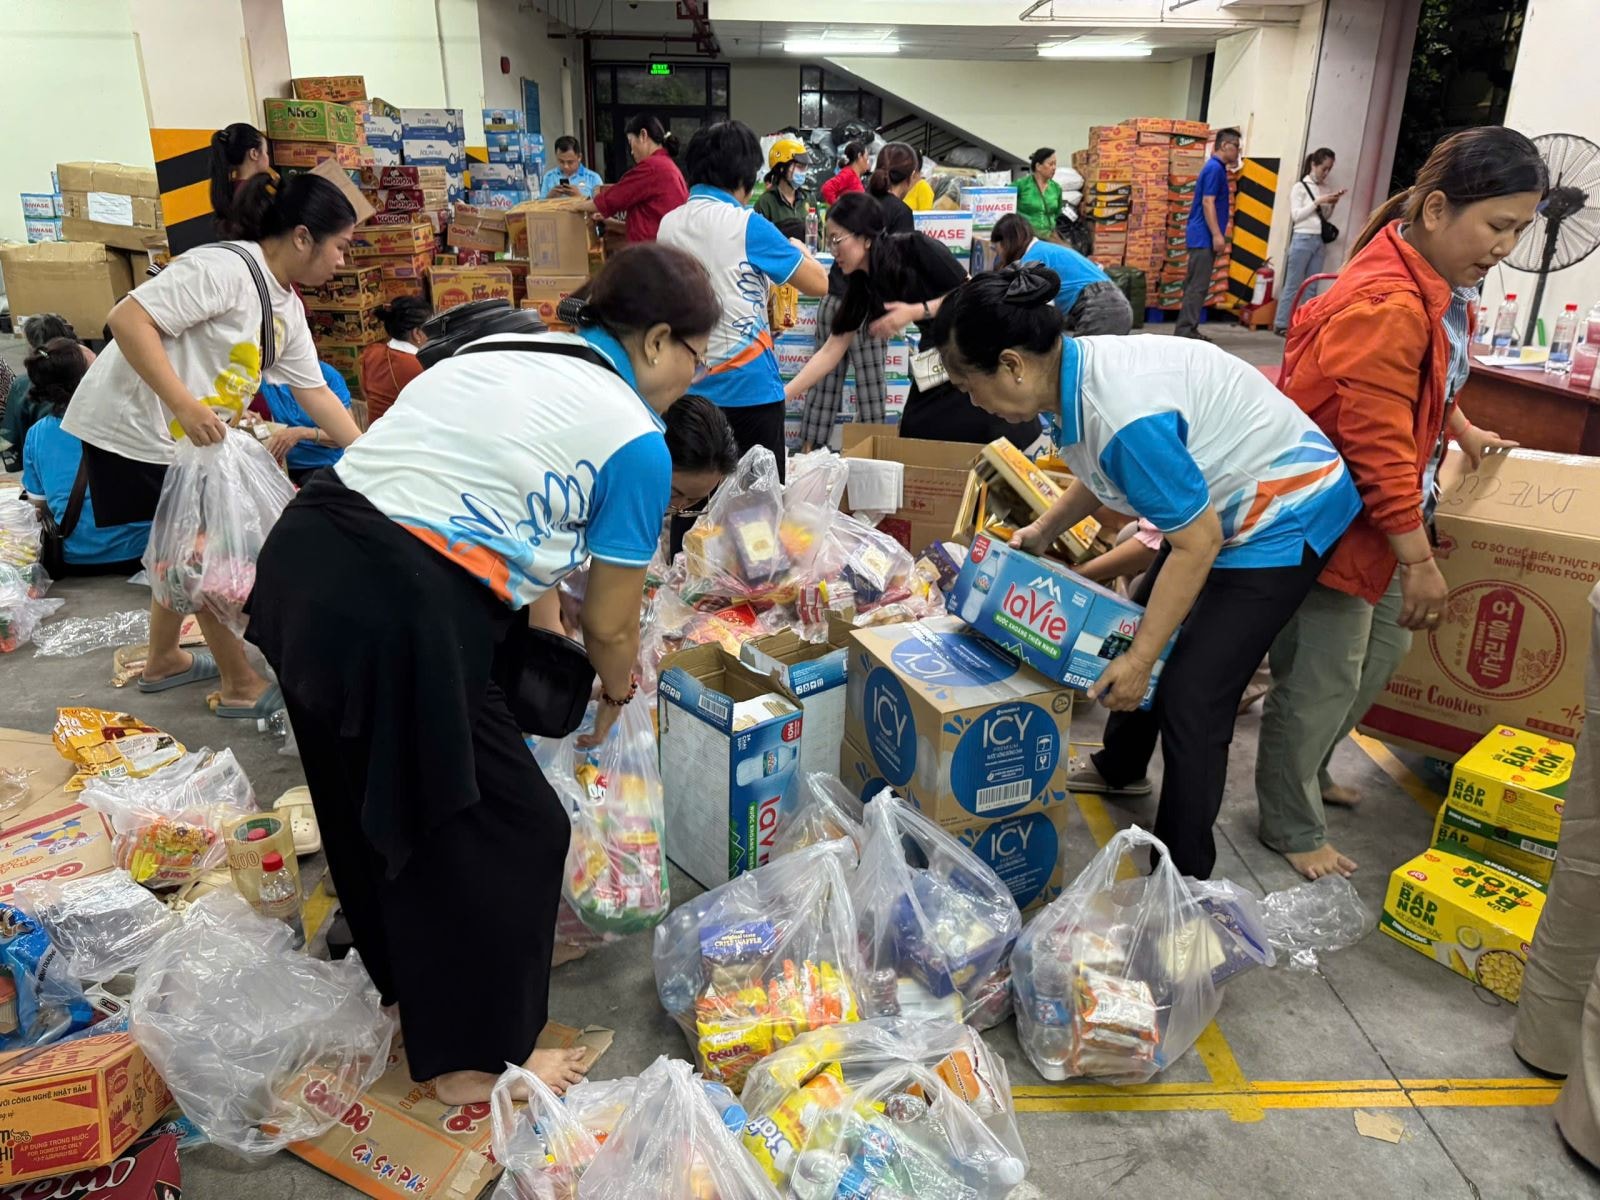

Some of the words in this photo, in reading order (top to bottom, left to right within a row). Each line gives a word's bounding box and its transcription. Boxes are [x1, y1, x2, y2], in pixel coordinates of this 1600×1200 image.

[383, 176, 414, 186] KOKOMI
[388, 200, 420, 210] KOKOMI
[976, 204, 1014, 212] BIWASE
[376, 214, 410, 222] KOKOMI
[1564, 569, 1596, 583] FOOD
[1002, 582, 1067, 640] laVie
[896, 652, 956, 680] ICY
[1427, 684, 1483, 717] Cookies
[872, 686, 908, 747] ICY
[983, 711, 1033, 748] ICY
[1452, 790, 1484, 807] NON
[990, 822, 1034, 861] ICY
[1396, 898, 1435, 926] NON
[11, 1094, 32, 1106] CÔNG
[53, 1088, 72, 1098] NHẬT
[73, 1084, 87, 1094] BẢN
[49, 1136, 70, 1147] TRONG
